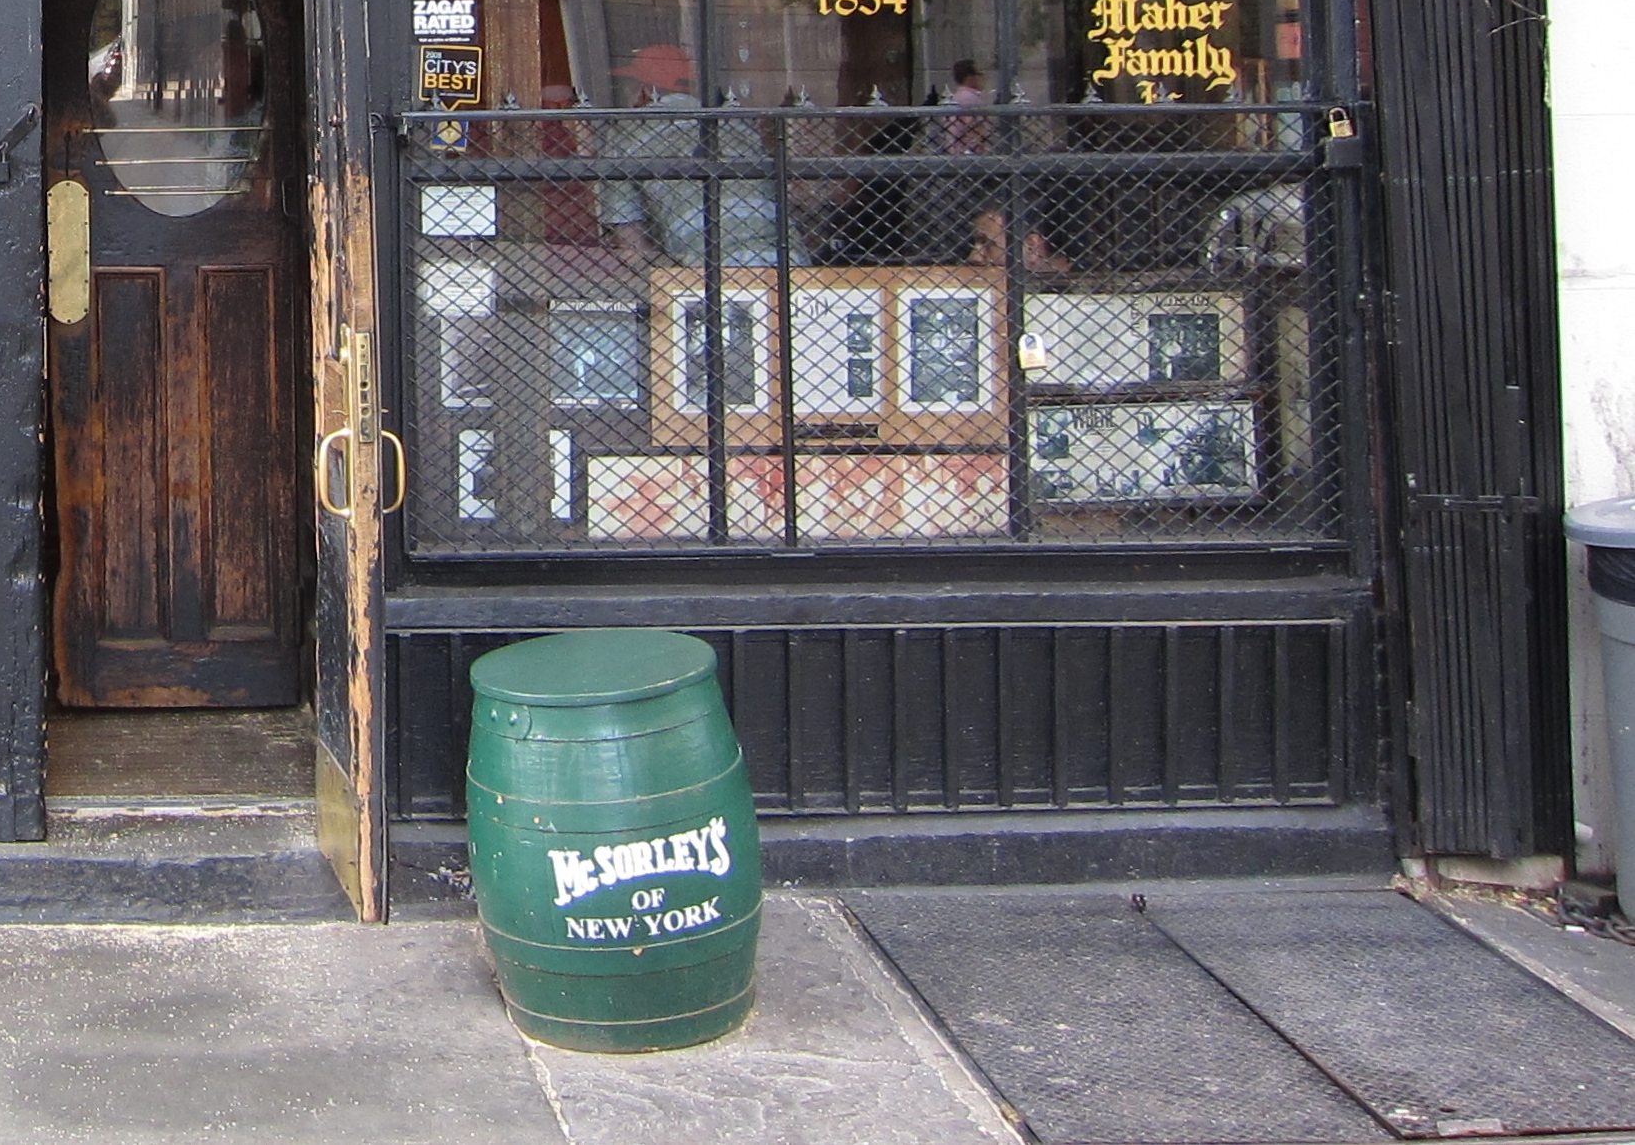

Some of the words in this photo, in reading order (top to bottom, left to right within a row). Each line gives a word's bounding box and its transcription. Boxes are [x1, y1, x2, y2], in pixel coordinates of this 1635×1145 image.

[413, 0, 475, 15] ZAGAT
[413, 15, 475, 30] RATED
[424, 59, 477, 75] CITY'S
[1092, 34, 1238, 91] Family
[424, 73, 476, 90] BEST
[631, 888, 666, 911] OF
[565, 917, 633, 940] NEW
[643, 896, 722, 936] YORK
